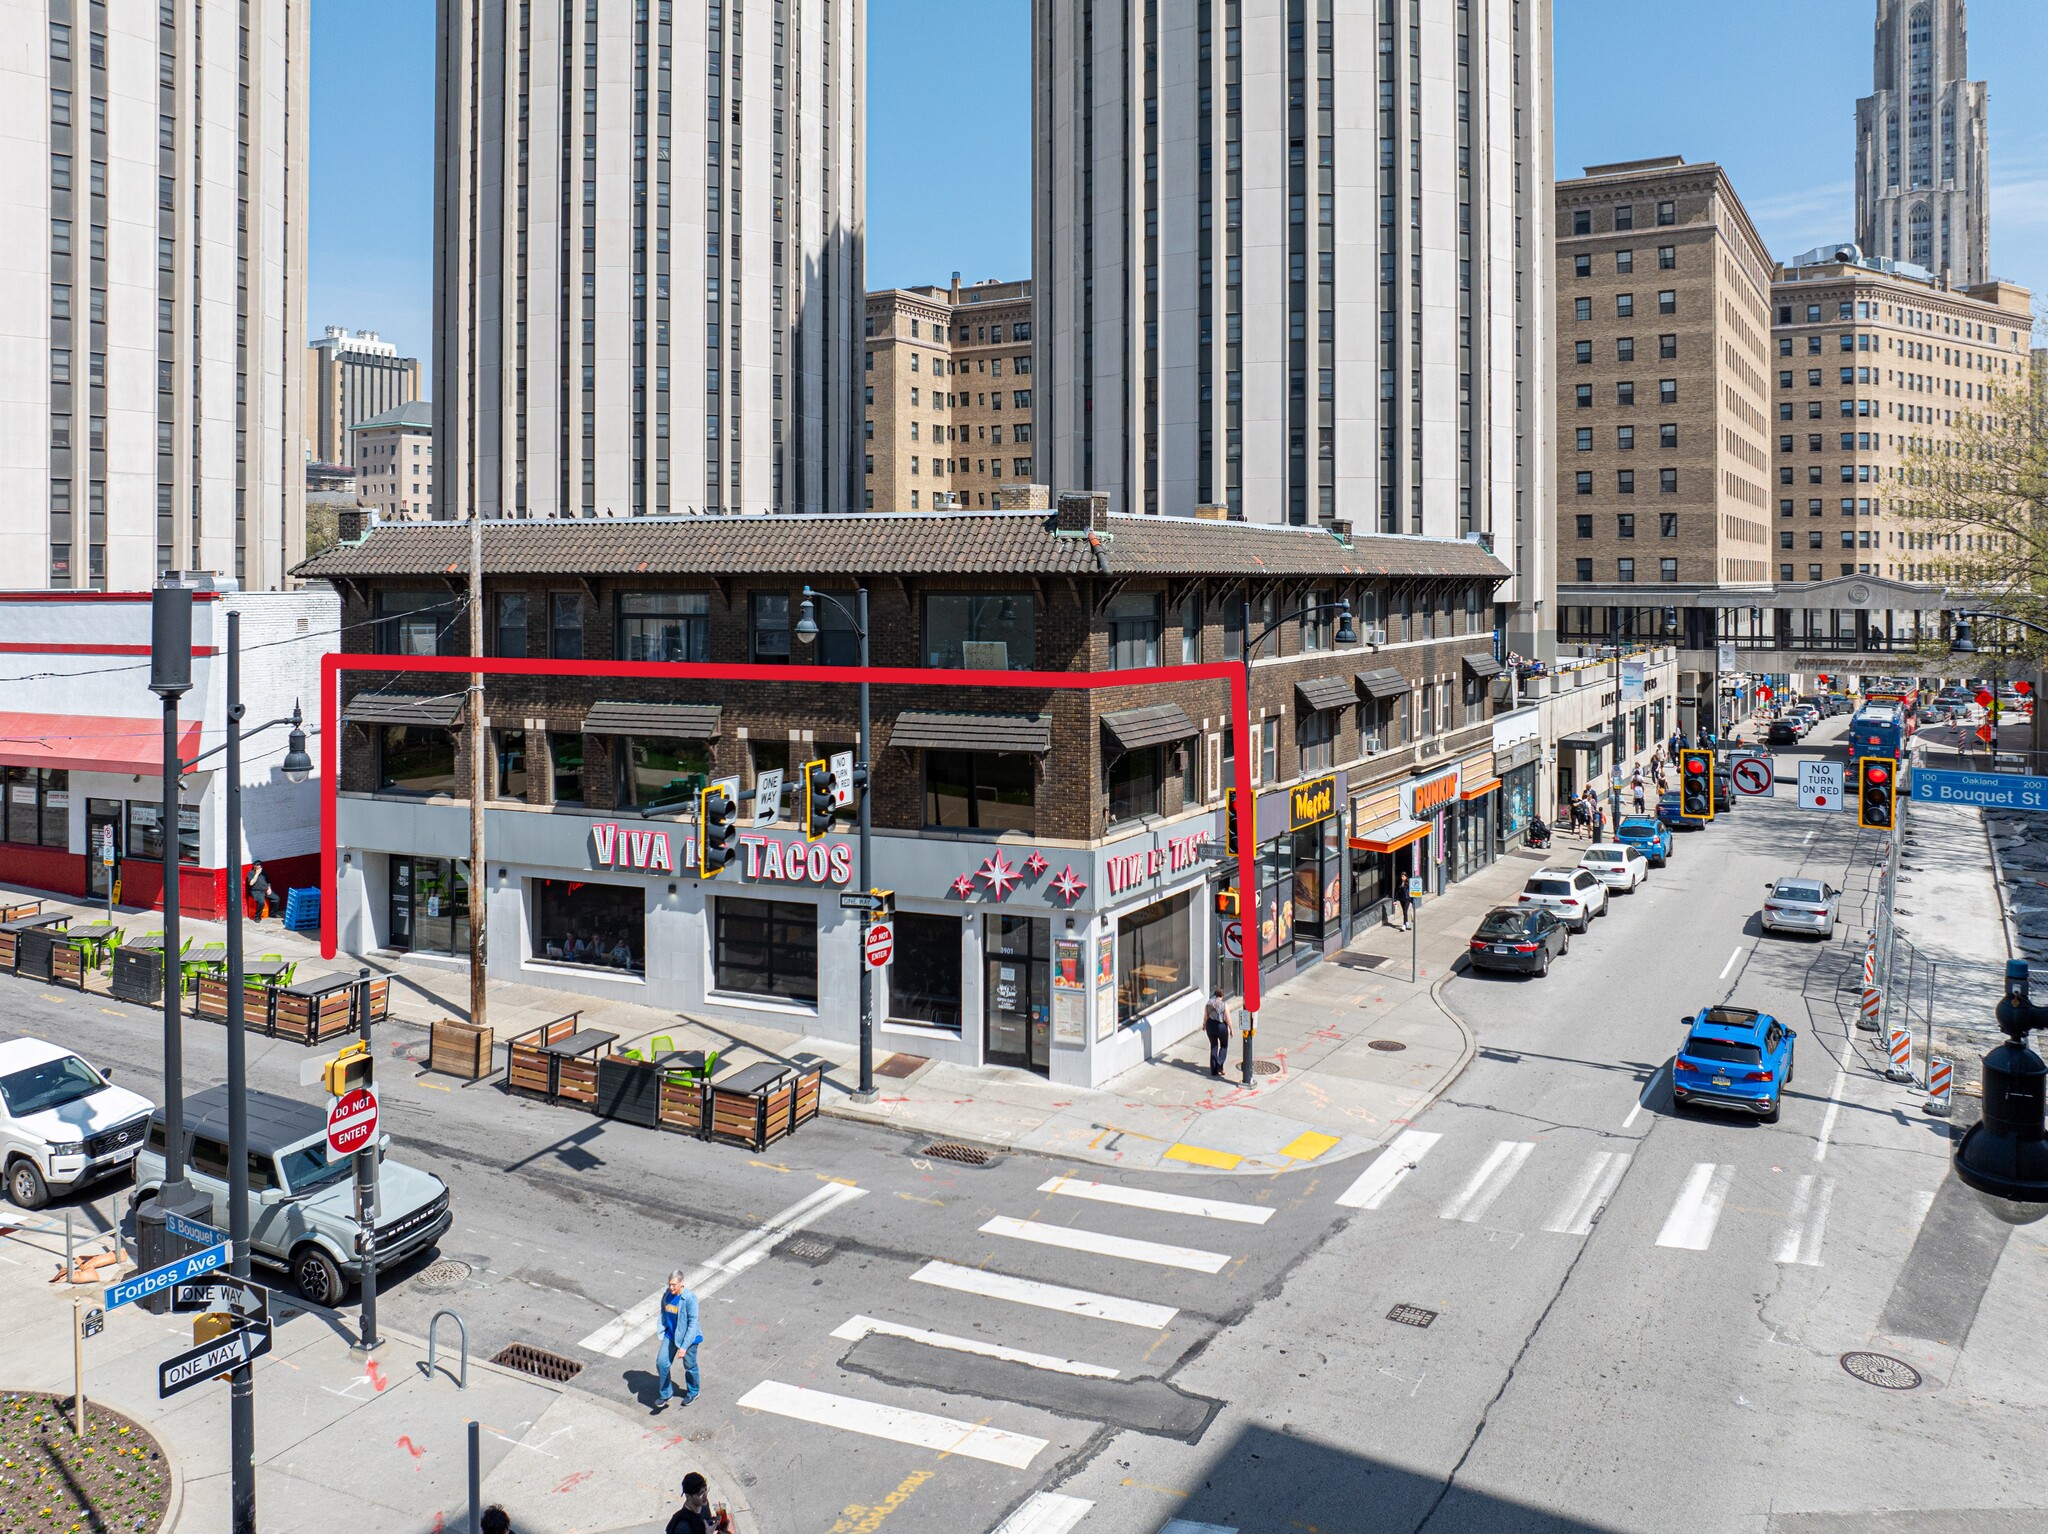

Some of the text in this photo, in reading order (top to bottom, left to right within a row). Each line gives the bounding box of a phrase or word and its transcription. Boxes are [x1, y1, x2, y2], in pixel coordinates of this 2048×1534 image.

[837, 757, 846, 769] NO
[1811, 765, 1830, 774] NO
[763, 776, 779, 790] ONE
[841, 778, 850, 788] RED
[1808, 776, 1834, 785] TURN
[1921, 773, 2041, 789] 100 Oakland 200
[760, 790, 778, 805] WAY
[1415, 773, 1458, 814] DUNKIN'
[1802, 785, 1839, 795] ON RED
[1921, 784, 2041, 806] S Bouquet St
[592, 823, 673, 871] VIVA
[739, 834, 852, 884] TACOS
[1215, 848, 1227, 856] WA
[1107, 852, 1144, 893] VIVA
[843, 897, 871, 906] ONE WAY
[870, 931, 889, 943] DO NOT
[871, 949, 888, 961] ENTER
[335, 1096, 371, 1119] DO NOT
[338, 1125, 368, 1145] ENTER
[169, 1216, 176, 1230] S
[178, 1220, 214, 1244] Bouquet
[114, 1254, 217, 1304] Forbes Ave
[183, 1286, 242, 1304] ONE WAY
[169, 1343, 238, 1384] ONE WAY
